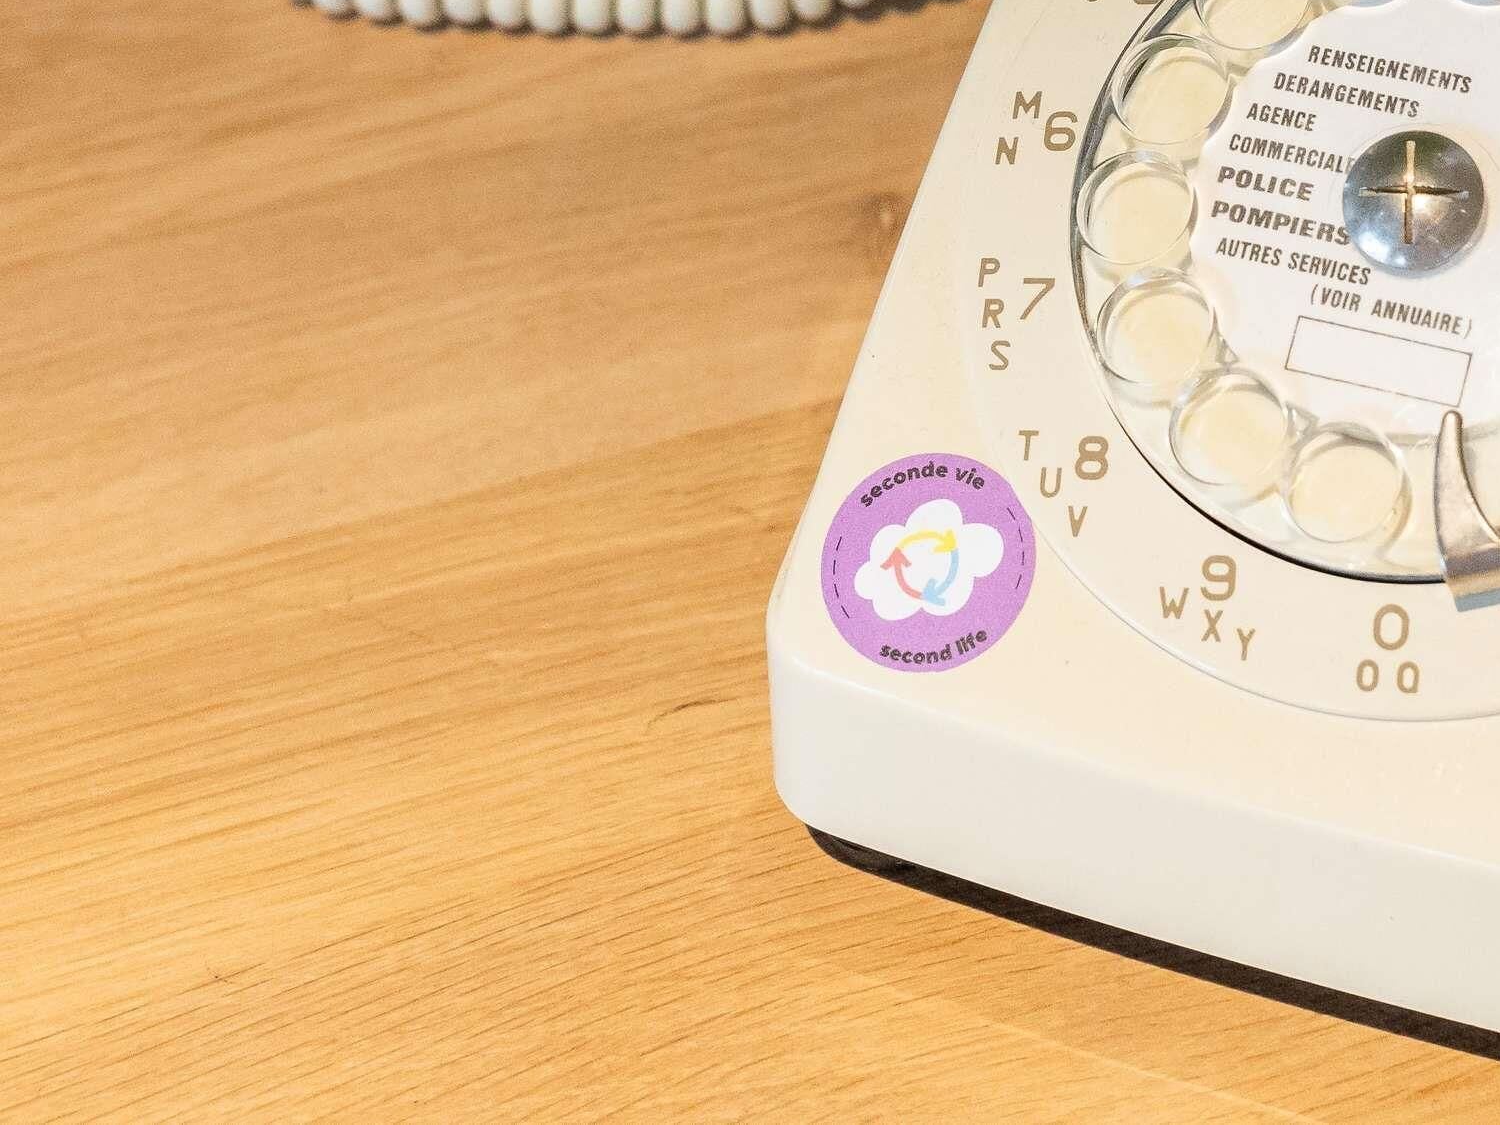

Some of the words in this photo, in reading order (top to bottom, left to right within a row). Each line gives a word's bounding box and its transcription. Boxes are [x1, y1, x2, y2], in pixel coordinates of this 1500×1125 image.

[1308, 45, 1472, 94] RENSEIGNEMENTS
[1246, 102, 1317, 132] AGENCE
[1274, 72, 1420, 119] DERANGEMENTS
[1044, 111, 1078, 151] 6
[1217, 166, 1314, 202] POLICE
[1210, 200, 1350, 246] POMPIERS
[1215, 237, 1281, 268] AUTRES
[1287, 252, 1371, 286] SERVICES
[1020, 278, 1055, 320] 7
[1310, 283, 1361, 312] (VOIR
[1370, 299, 1473, 339] ANNUAIRE)
[1075, 435, 1108, 480] 8
[860, 461, 949, 507] seconde
[955, 467, 985, 490] vie
[1201, 555, 1236, 601] 9
[880, 643, 953, 665] second
[956, 629, 988, 655] life
